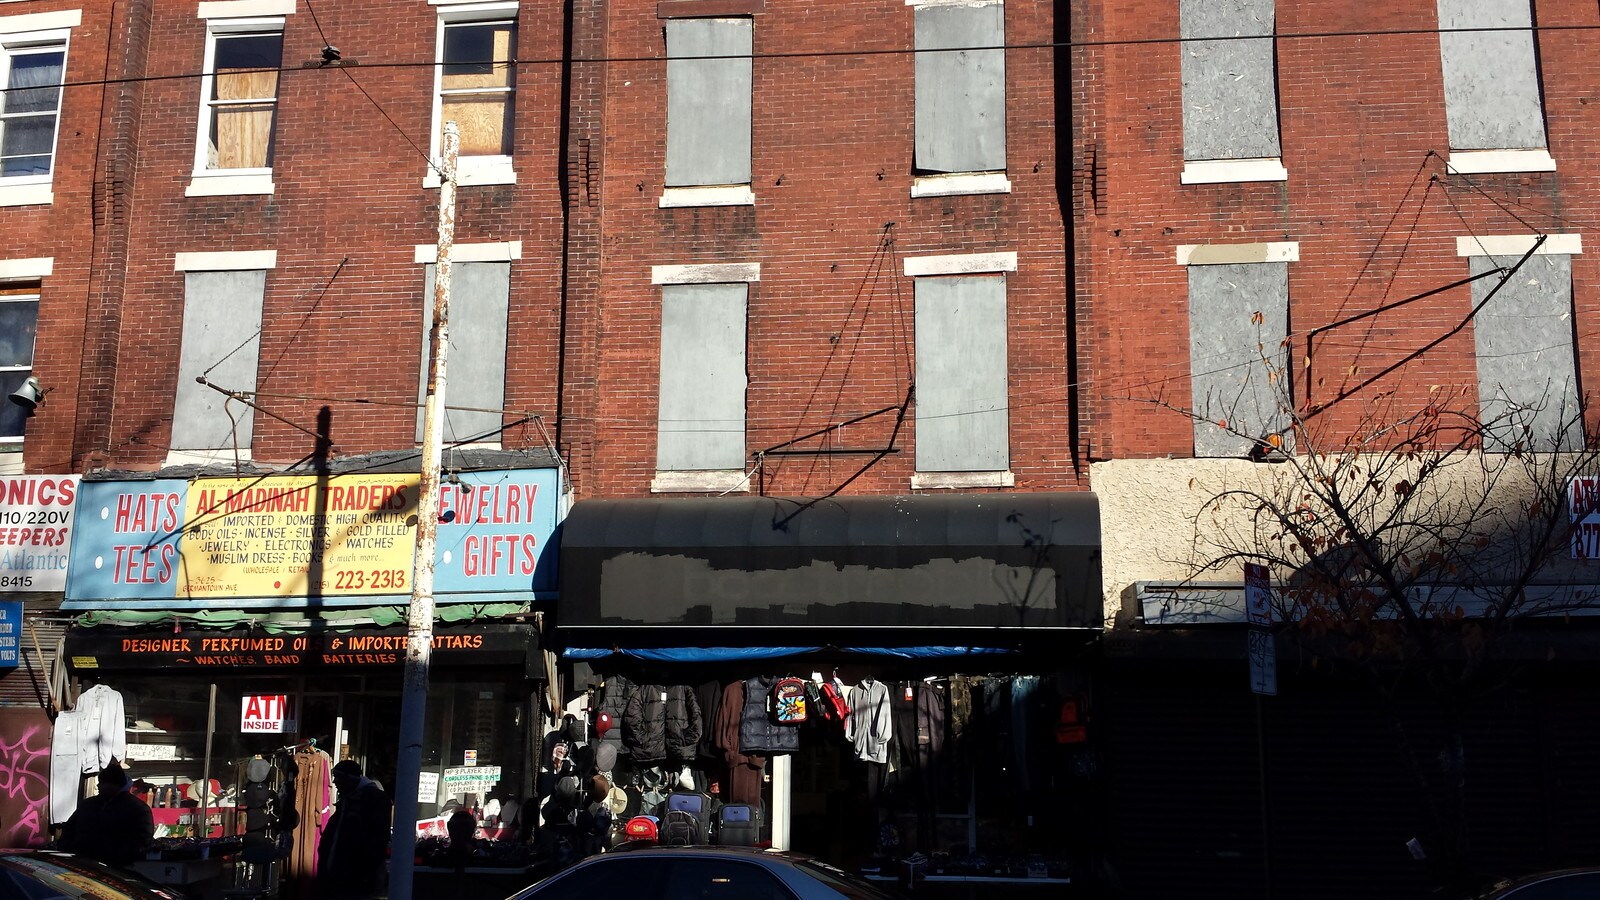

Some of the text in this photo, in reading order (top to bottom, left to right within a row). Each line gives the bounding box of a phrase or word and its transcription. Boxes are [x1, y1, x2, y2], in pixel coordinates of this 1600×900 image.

[195, 485, 408, 515] AL-MADINAH TRADERS
[437, 484, 537, 524] EWELRY
[1573, 479, 1600, 514] AT
[114, 493, 180, 533] HATS
[223, 515, 274, 527] IMPORTED
[286, 514, 332, 527] DOMESTIC
[336, 514, 357, 526] HIGH
[362, 513, 407, 525] QUALITY
[189, 528, 214, 541] BODY
[217, 529, 238, 541] OILS
[245, 528, 286, 539] INCENSE
[296, 527, 330, 538] SILVER
[346, 525, 372, 538] GOLD
[376, 525, 410, 537] FILLED
[201, 537, 394, 553] JEWELRY ELECTRONICS WATCHES
[0, 549, 67, 570] Atlantic
[113, 543, 174, 584] TEES
[210, 553, 249, 565] MUSLIM
[252, 552, 285, 564] DRESS
[293, 552, 323, 564] BOOKS
[337, 553, 356, 563] much
[464, 533, 537, 577] GIFTS
[1, 576, 32, 588] 8415
[183, 584, 238, 593] GERMANTOWN AVE
[335, 569, 405, 590] 223-2313
[122, 638, 191, 653] DESIGNER
[202, 637, 284, 652] PERFUMED
[332, 636, 343, 650] &
[349, 635, 408, 650] IMPORTE
[266, 655, 300, 664] BAND
[323, 653, 397, 664] BATTERIES
[245, 695, 296, 720] ATM
[243, 721, 279, 731] INSIDE
